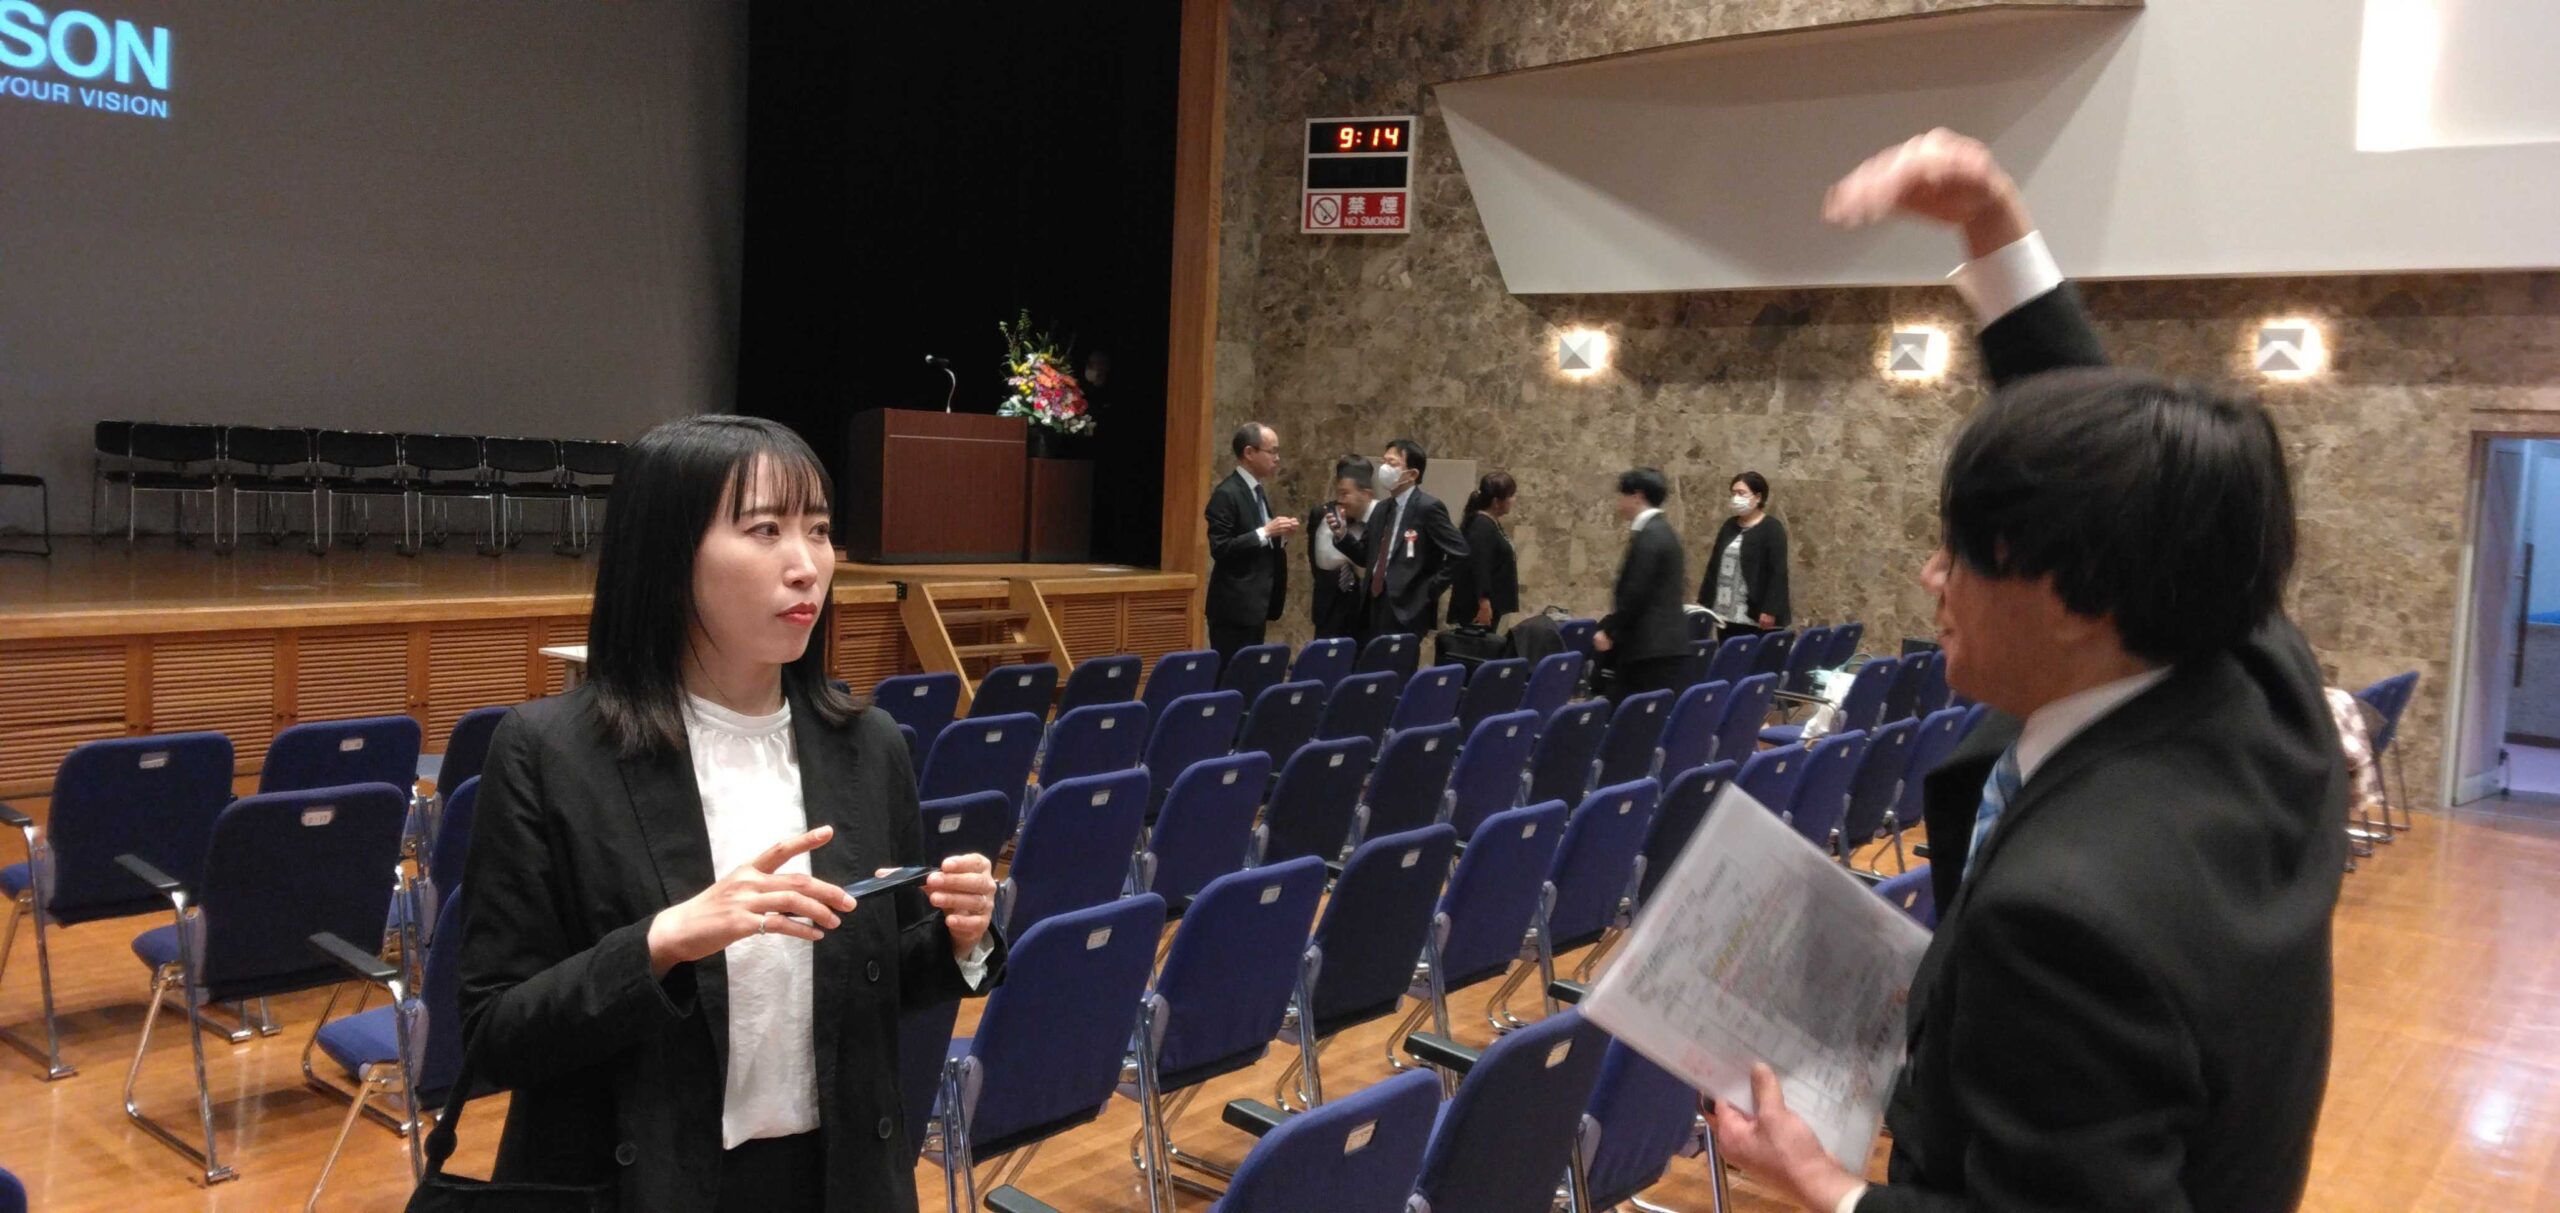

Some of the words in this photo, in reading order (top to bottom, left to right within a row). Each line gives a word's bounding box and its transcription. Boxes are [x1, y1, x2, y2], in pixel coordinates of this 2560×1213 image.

[0, 0, 169, 91] SON
[80, 87, 168, 119] VISION
[1339, 127, 1400, 149] 9:14
[1343, 216, 1359, 226] NO
[1360, 216, 1400, 226] SMOKING
